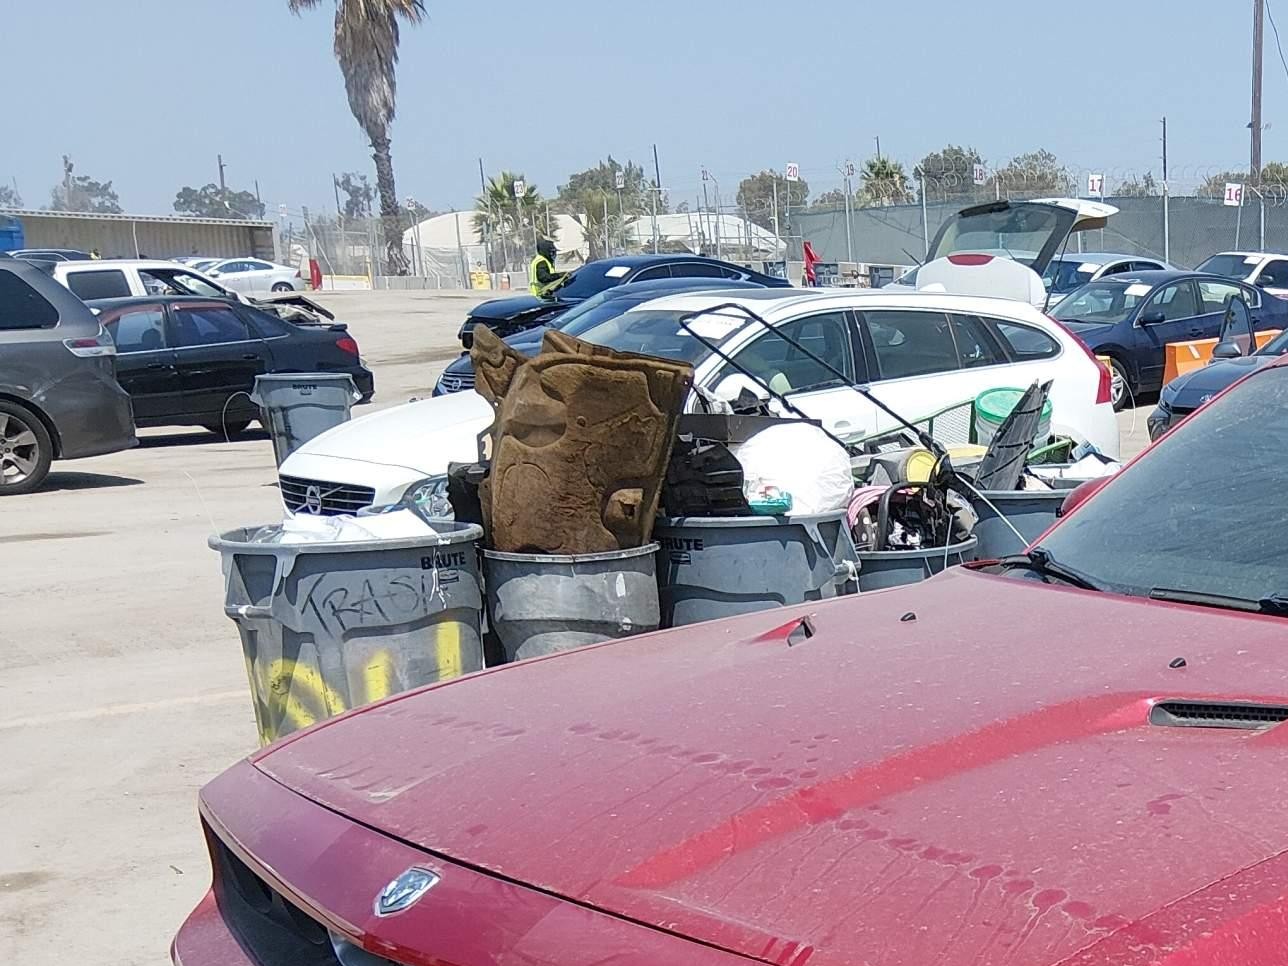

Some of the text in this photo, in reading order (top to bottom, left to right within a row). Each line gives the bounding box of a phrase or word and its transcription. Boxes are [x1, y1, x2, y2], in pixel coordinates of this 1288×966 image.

[701, 169, 709, 181] 21
[787, 166, 798, 177] 20
[846, 163, 855, 176] 19
[974, 168, 984, 181] 18
[515, 184, 524, 194] 23
[1089, 179, 1104, 193] 17
[1225, 188, 1241, 202] 16
